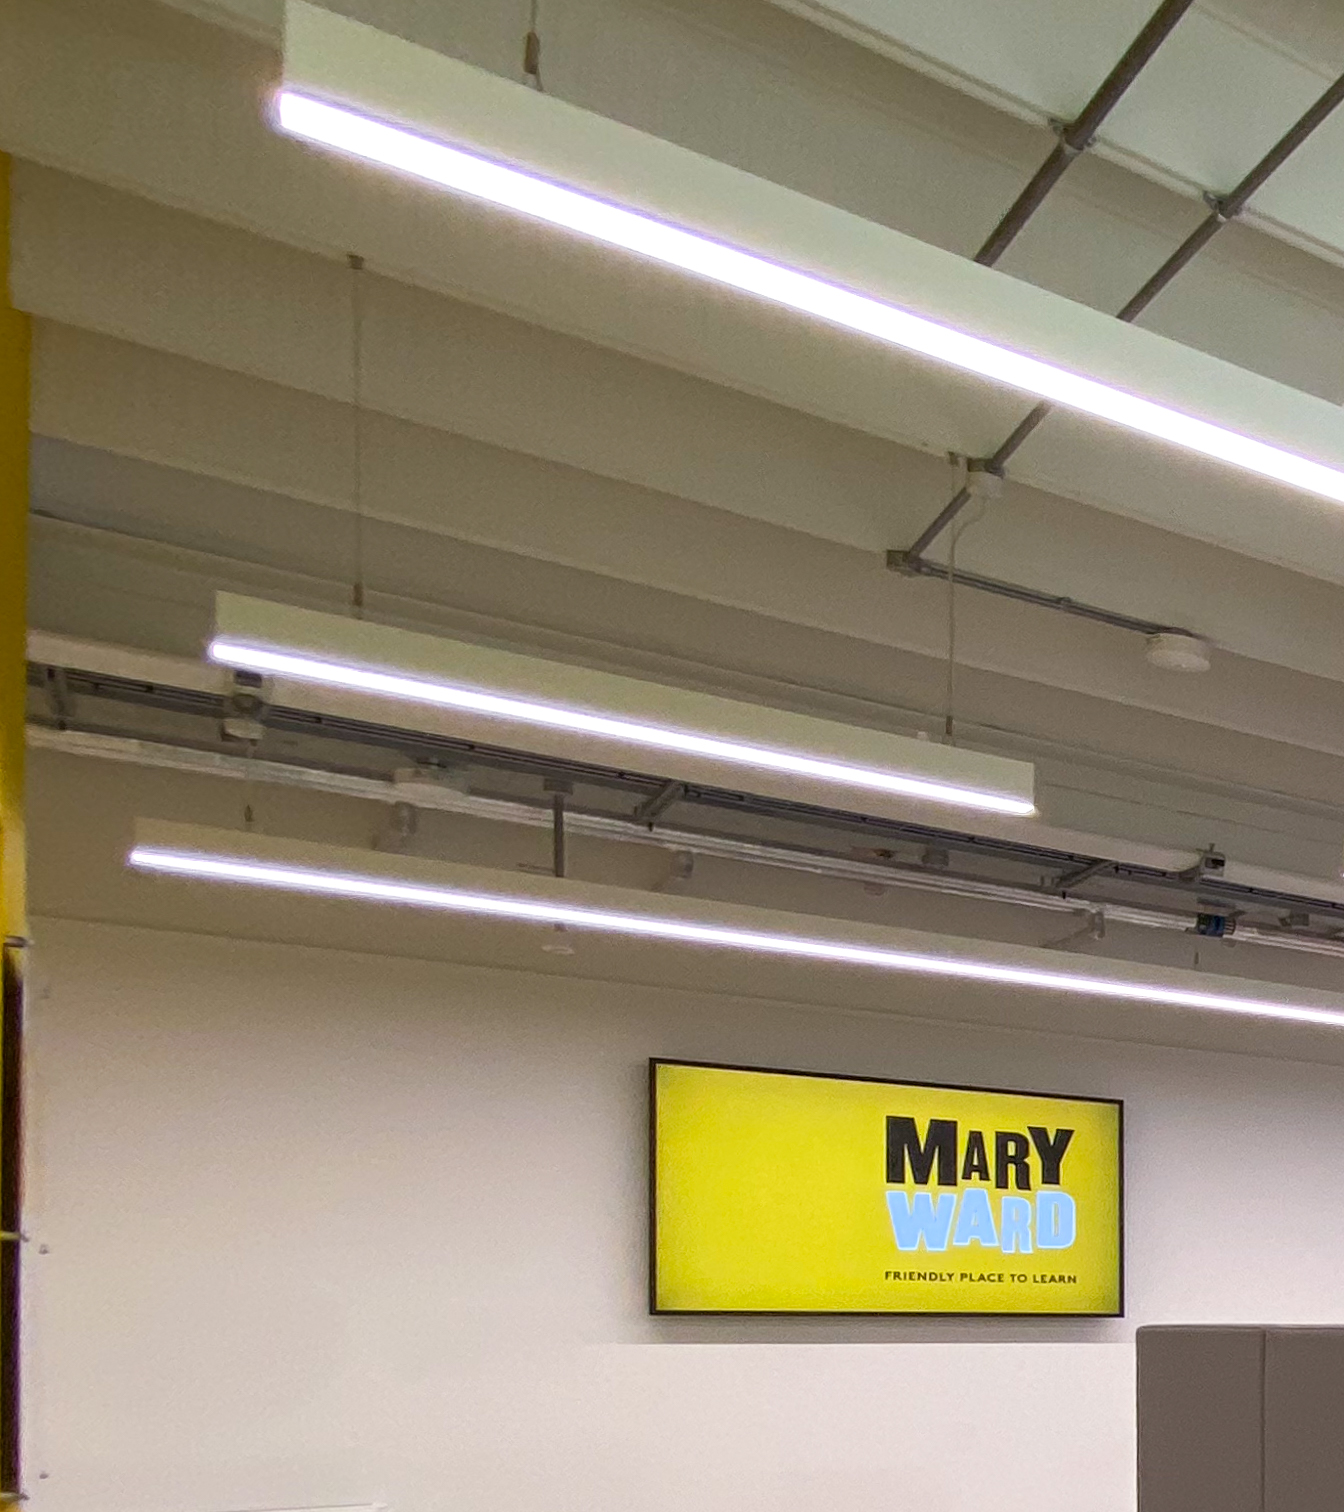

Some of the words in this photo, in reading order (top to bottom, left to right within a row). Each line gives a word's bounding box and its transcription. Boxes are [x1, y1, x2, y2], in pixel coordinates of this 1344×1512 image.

[886, 1115, 1075, 1191] MARY
[885, 1188, 1077, 1254] WARD
[884, 1270, 955, 1283] FRIENDLY
[959, 1272, 1005, 1284] PLACE
[1009, 1273, 1028, 1284] TO
[1032, 1273, 1078, 1285] LEARN
